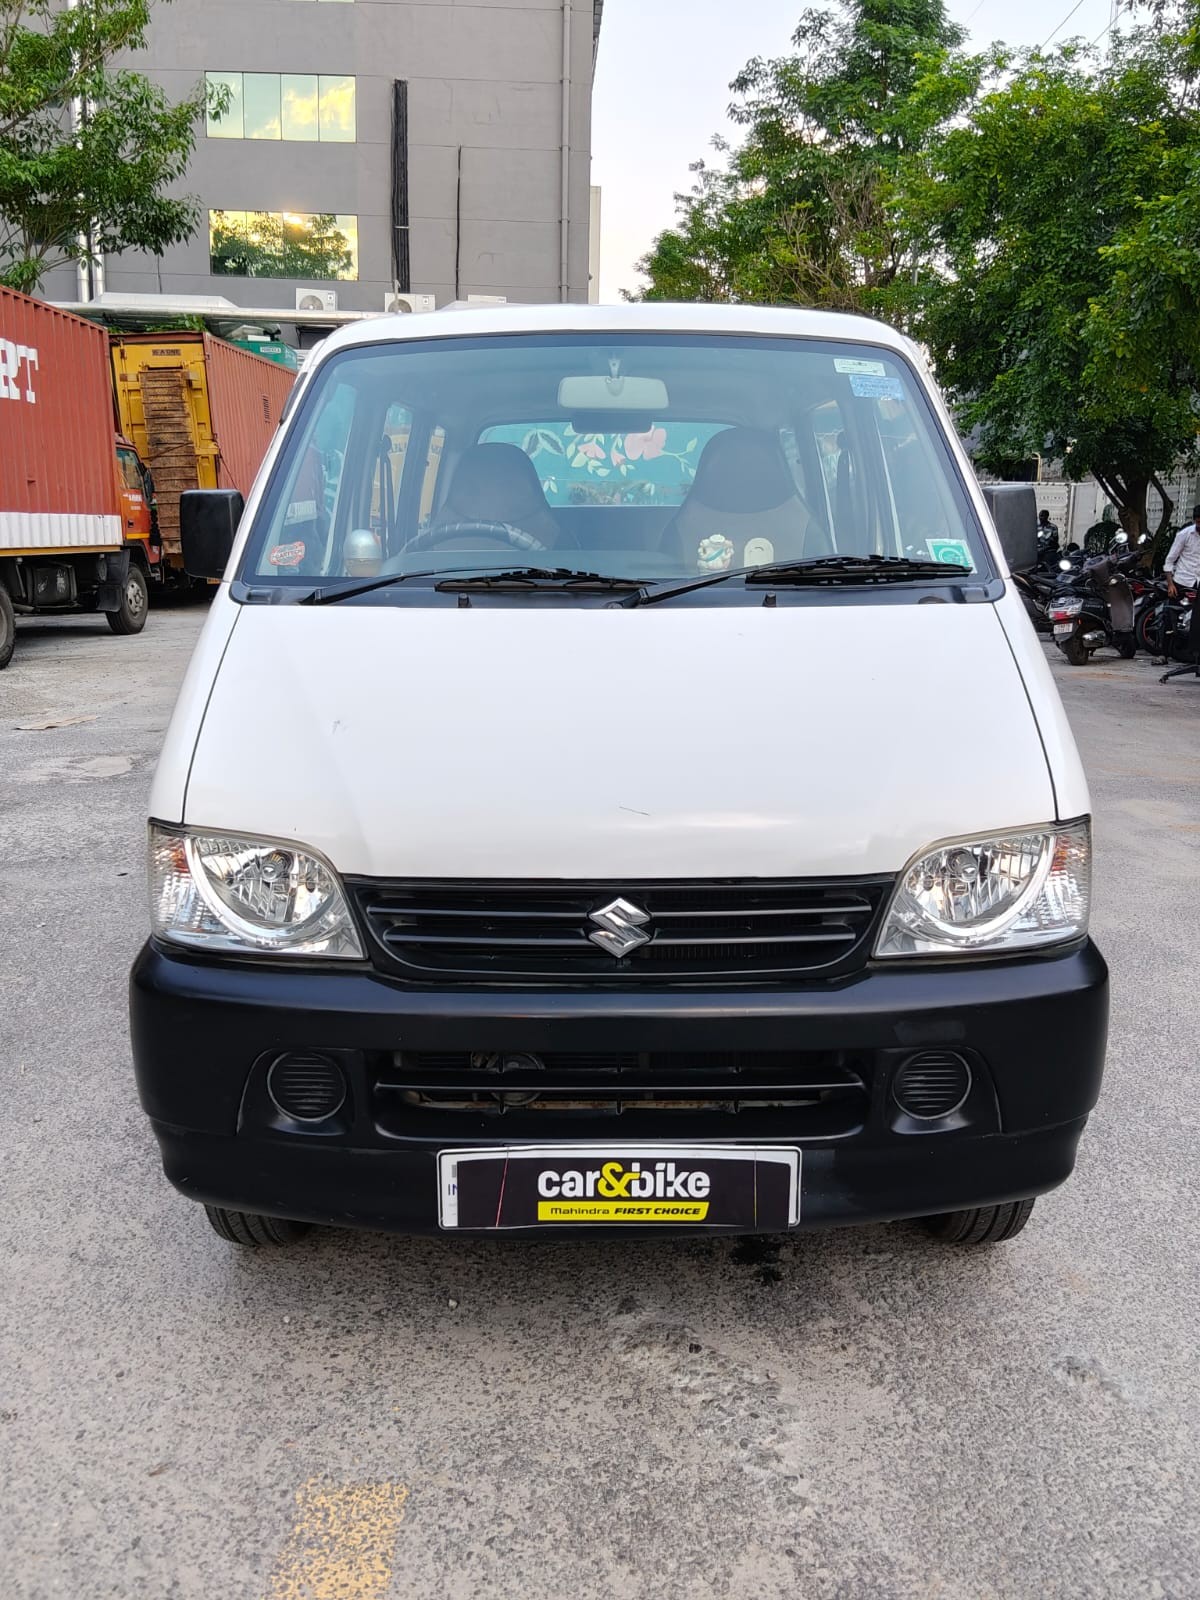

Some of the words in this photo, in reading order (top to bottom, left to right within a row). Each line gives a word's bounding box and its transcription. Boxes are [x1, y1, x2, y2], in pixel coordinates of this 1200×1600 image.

[537, 1161, 711, 1198] car&bike
[550, 1207, 610, 1215] Mahindra
[613, 1207, 653, 1215] FIRST
[653, 1207, 702, 1215] CHOICE
